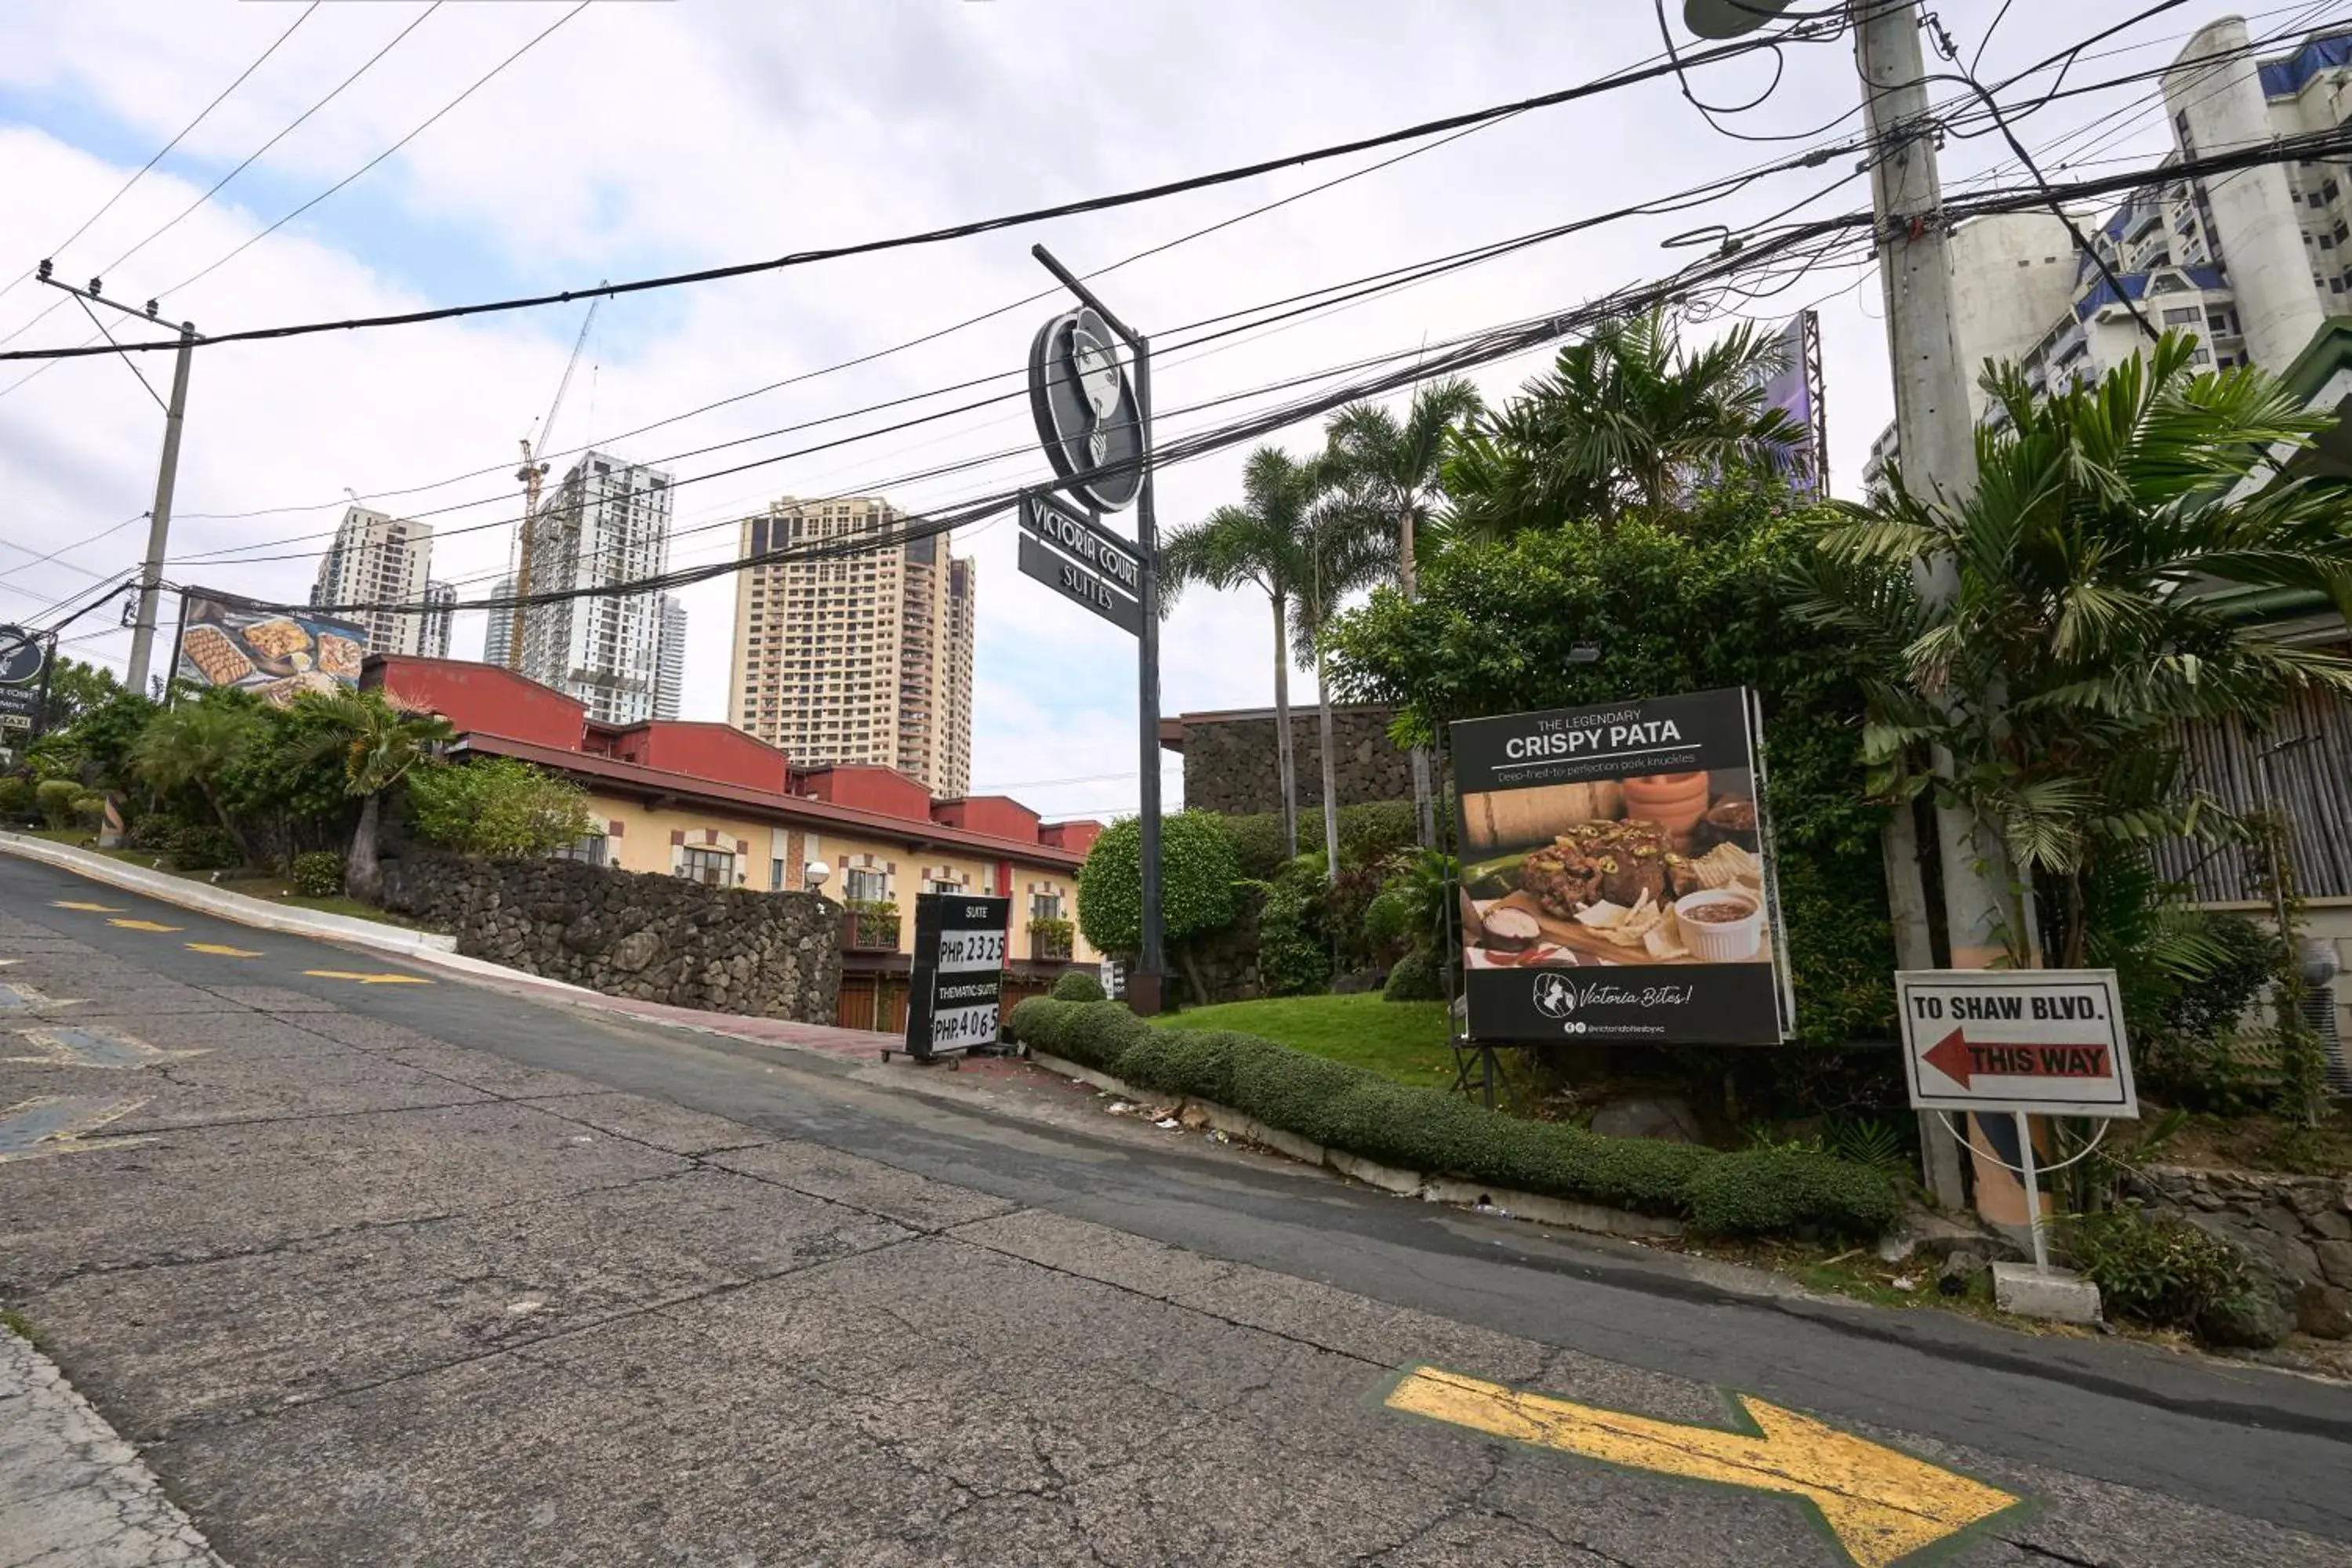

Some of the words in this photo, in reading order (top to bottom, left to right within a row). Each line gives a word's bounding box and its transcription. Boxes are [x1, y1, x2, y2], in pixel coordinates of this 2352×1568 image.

[1032, 498, 1095, 561] VICTORIA
[1100, 546, 1138, 588] COURT
[1064, 564, 1113, 609] SUITES
[1537, 719, 1563, 731] THE
[1566, 709, 1642, 729] LEGENDARY
[1506, 728, 1603, 759] CRISPY
[1610, 719, 1682, 747] PATA
[1647, 753, 1696, 766] knuckles
[965, 906, 989, 918] SUITE
[939, 984, 977, 1000] THEMATIC
[978, 982, 998, 996] SUITE
[1580, 982, 1639, 1008] Victoria
[1641, 984, 1693, 1008] Bites!
[1914, 996, 1943, 1020] TO
[1951, 996, 2023, 1020] SHAW
[2031, 995, 2105, 1021] BLVD.
[1968, 1046, 2034, 1073] THIS
[2040, 1047, 2105, 1075] WAY
